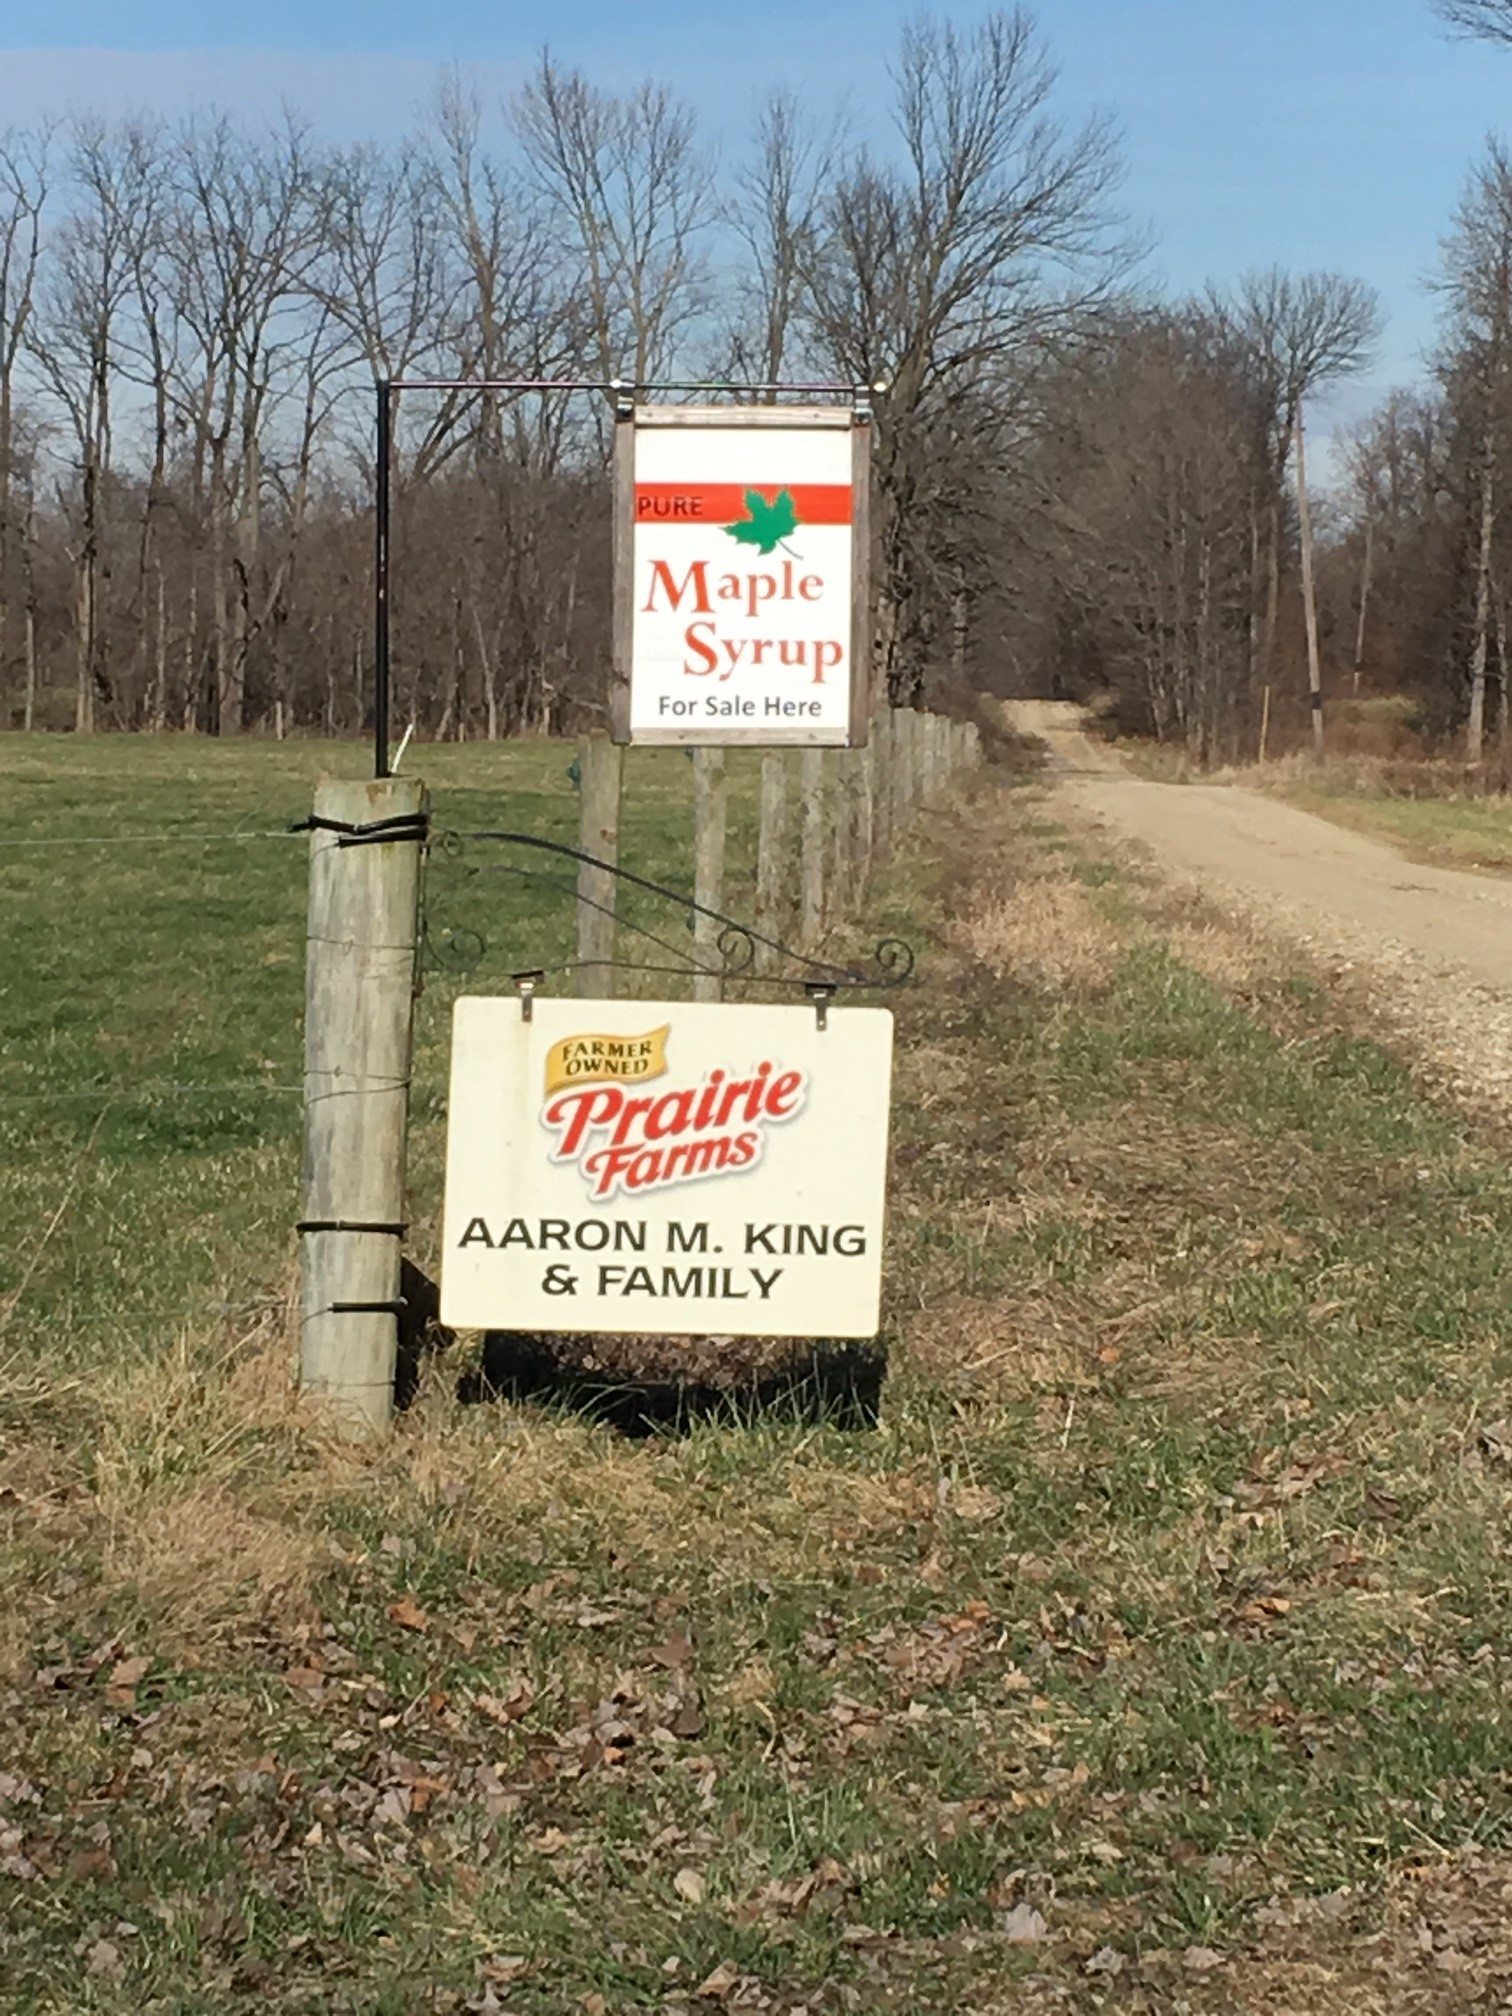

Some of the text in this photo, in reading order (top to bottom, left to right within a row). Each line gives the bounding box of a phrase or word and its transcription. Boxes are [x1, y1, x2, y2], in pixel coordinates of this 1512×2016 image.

[638, 496, 703, 517] PURE
[641, 559, 824, 617] Maple
[683, 621, 843, 683] Syrup
[659, 696, 822, 716] For Sale Here
[562, 1040, 653, 1061] FARMER
[566, 1058, 649, 1076] OWNED
[545, 1061, 802, 1156] Prairie
[586, 1131, 758, 1195] Farms
[457, 1217, 867, 1256] AARON M. KING
[541, 1264, 783, 1299] & FAMILY
